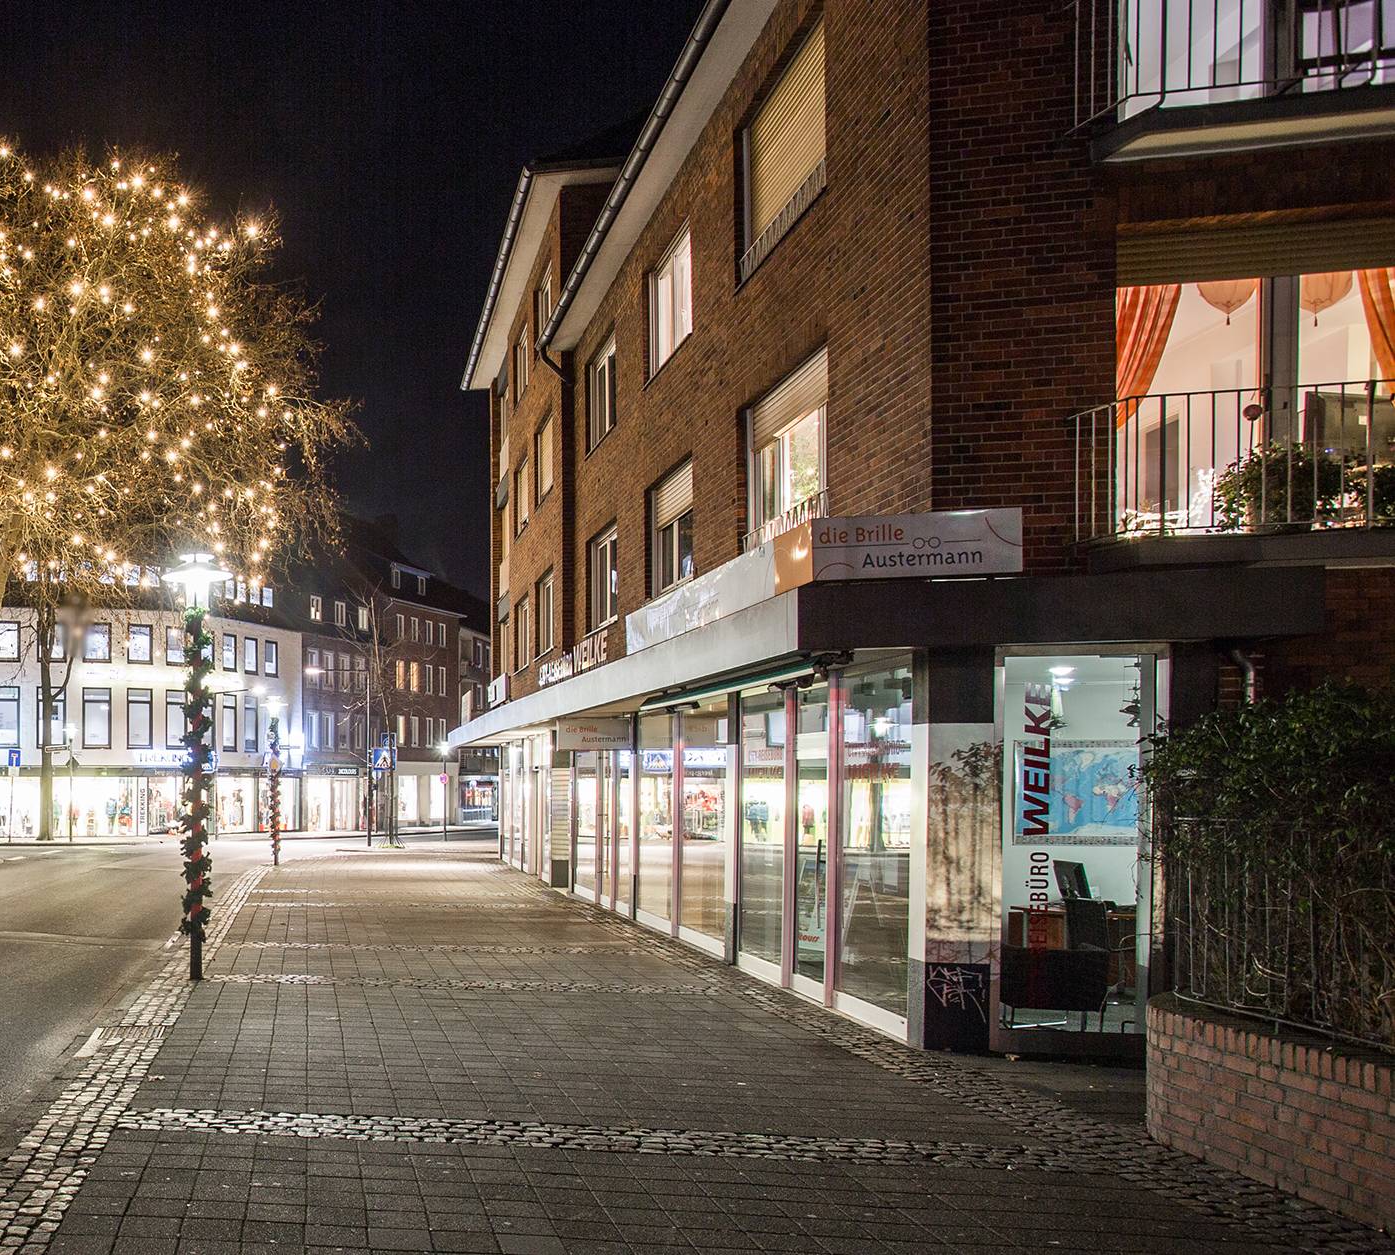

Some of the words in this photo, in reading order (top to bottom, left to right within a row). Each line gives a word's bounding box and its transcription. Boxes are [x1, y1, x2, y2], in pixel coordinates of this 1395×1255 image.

[819, 526, 848, 544] die
[855, 524, 904, 542] Brille
[862, 549, 983, 569] Austermann
[573, 629, 608, 674] WEILKE
[581, 735, 627, 743] Austermann
[1022, 681, 1051, 836] WEILKE
[139, 788, 147, 824] TREKKING
